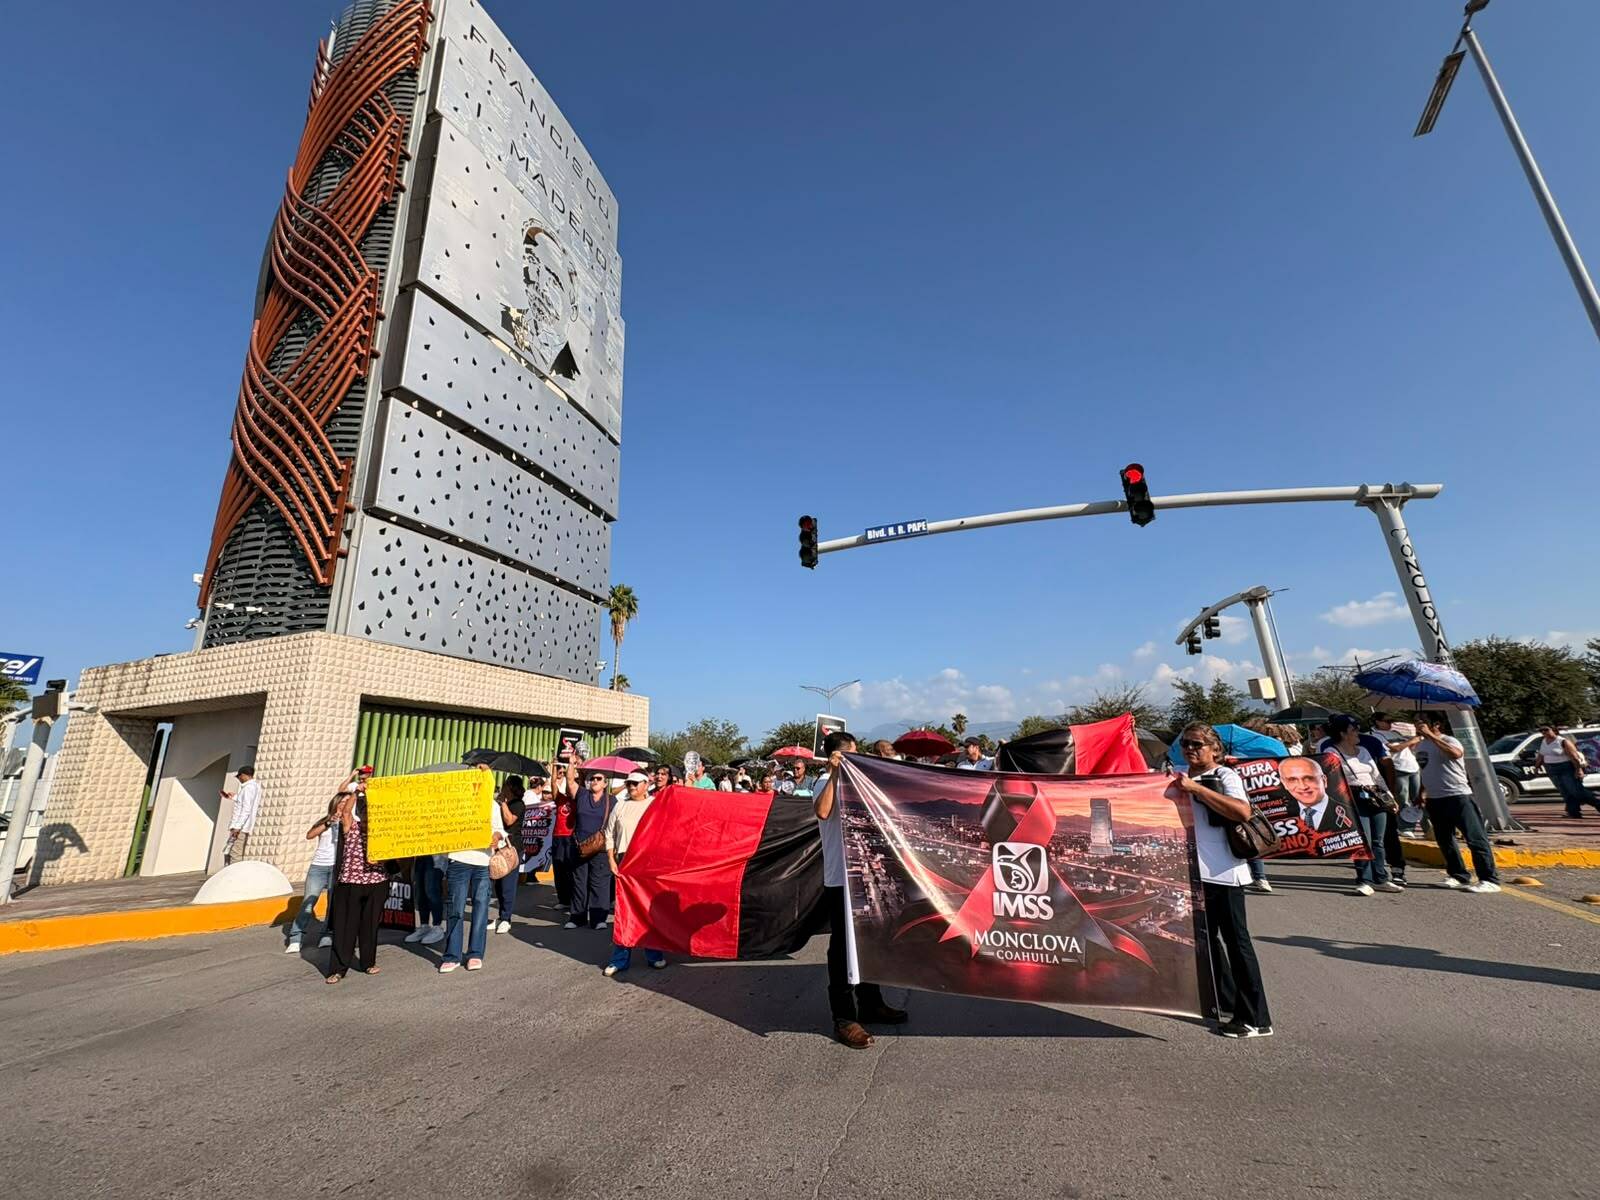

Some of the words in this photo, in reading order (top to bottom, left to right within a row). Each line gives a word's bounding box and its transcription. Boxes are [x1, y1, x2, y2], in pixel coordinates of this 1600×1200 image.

[469, 24, 609, 220] FRANCISCO
[510, 140, 608, 271] MADERO
[868, 528, 887, 539] Blvd.
[907, 521, 927, 533] PAPE
[0, 658, 39, 675] el
[1322, 841, 1348, 854] FAMILIA
[1347, 836, 1364, 847] IMSS
[993, 891, 1054, 920] IMSS
[974, 929, 1083, 953] MONCLOVA
[996, 950, 1060, 964] COAHUILA
